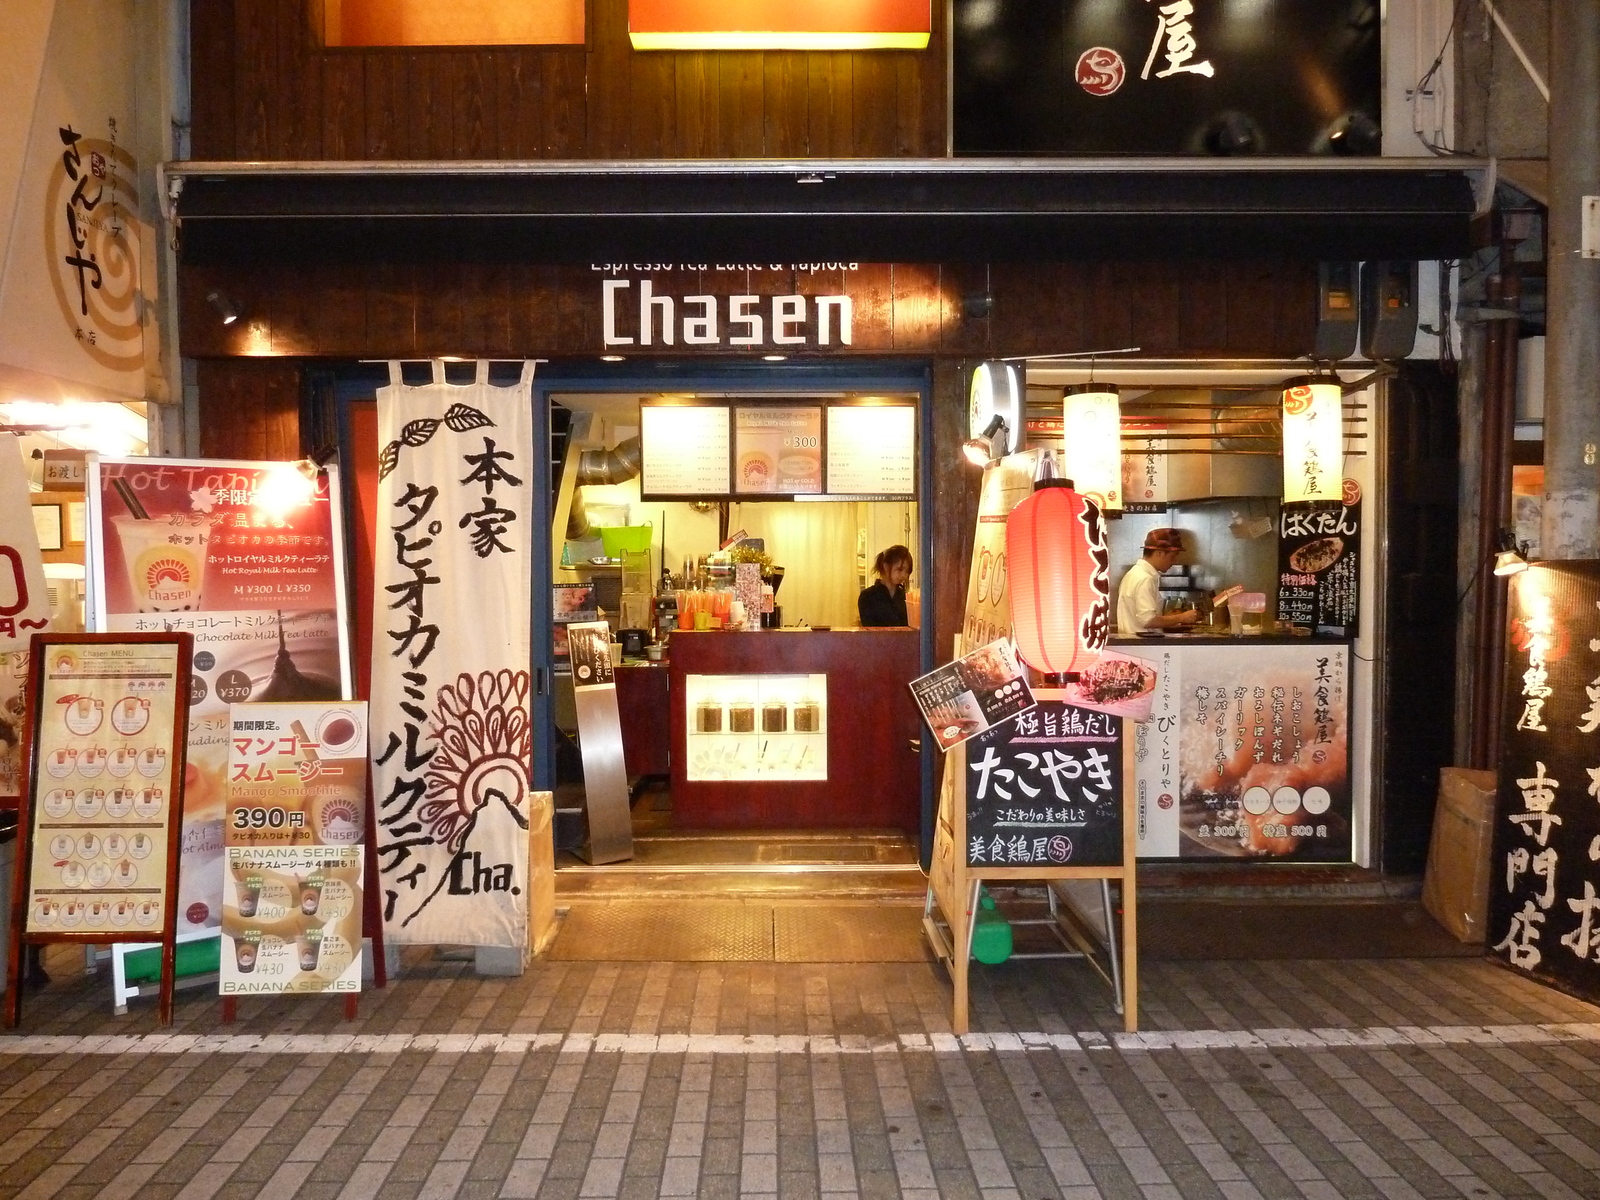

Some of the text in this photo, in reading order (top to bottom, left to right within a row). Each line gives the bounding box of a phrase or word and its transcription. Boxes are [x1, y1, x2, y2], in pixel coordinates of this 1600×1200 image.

[1141, 0, 1215, 79] 屋
[59, 124, 102, 316] さんじや
[602, 279, 852, 346] Chasen
[793, 436, 818, 448] 300
[48, 464, 86, 480] お渡し
[180, 466, 331, 494] Tapia
[459, 437, 523, 558] 本家
[1281, 508, 1357, 539] はくだん
[208, 554, 330, 564] ホットロイヤルミルクティーラテ
[222, 566, 318, 577] Hot Royal Milk Tea Latte
[149, 589, 192, 601] Chasen
[234, 584, 311, 594] M ¥300 L ¥350
[196, 631, 253, 643] Chocolate
[254, 631, 279, 641] Milk
[303, 629, 330, 638] Latte
[83, 649, 134, 657] Chasen MENU
[231, 674, 238, 684] L
[220, 686, 249, 698] ¥370
[377, 483, 442, 922] タピオカミルクティー
[1313, 657, 1334, 744] 美食鶏屋
[1195, 686, 1210, 725] 梅しそ
[233, 720, 280, 731] 期間限定。
[1015, 708, 1116, 736] 極旨鶏だし
[1234, 686, 1247, 752] ガーリック
[1253, 686, 1265, 764] おろしぽんず
[1272, 686, 1285, 763] 秘伝ネギだれ
[1291, 686, 1302, 764] しおこしょう
[1215, 686, 1227, 777] スパイシーチリ
[233, 734, 321, 757] マンゴー
[1157, 714, 1177, 788] びくとりや
[231, 762, 343, 783] スムージー
[970, 747, 1113, 802] たこやき
[231, 785, 342, 798] Mango Smoothie
[233, 808, 304, 829] 390 円
[996, 807, 1086, 822] こだわりの美味しさ
[321, 828, 359, 840] Chasen
[1291, 825, 1314, 837] 500
[229, 847, 360, 858] BANANA SERIES
[969, 833, 1049, 863] 美食鶏屋
[232, 861, 313, 870] 生バナナスムージーが
[315, 860, 322, 868] 4
[324, 860, 348, 868] 種類も
[447, 849, 521, 896] Cha.
[1494, 760, 1562, 971] 専門店
[257, 906, 285, 918] ¥400
[256, 963, 284, 975] ¥430
[223, 980, 357, 992] BANANA SERIES
